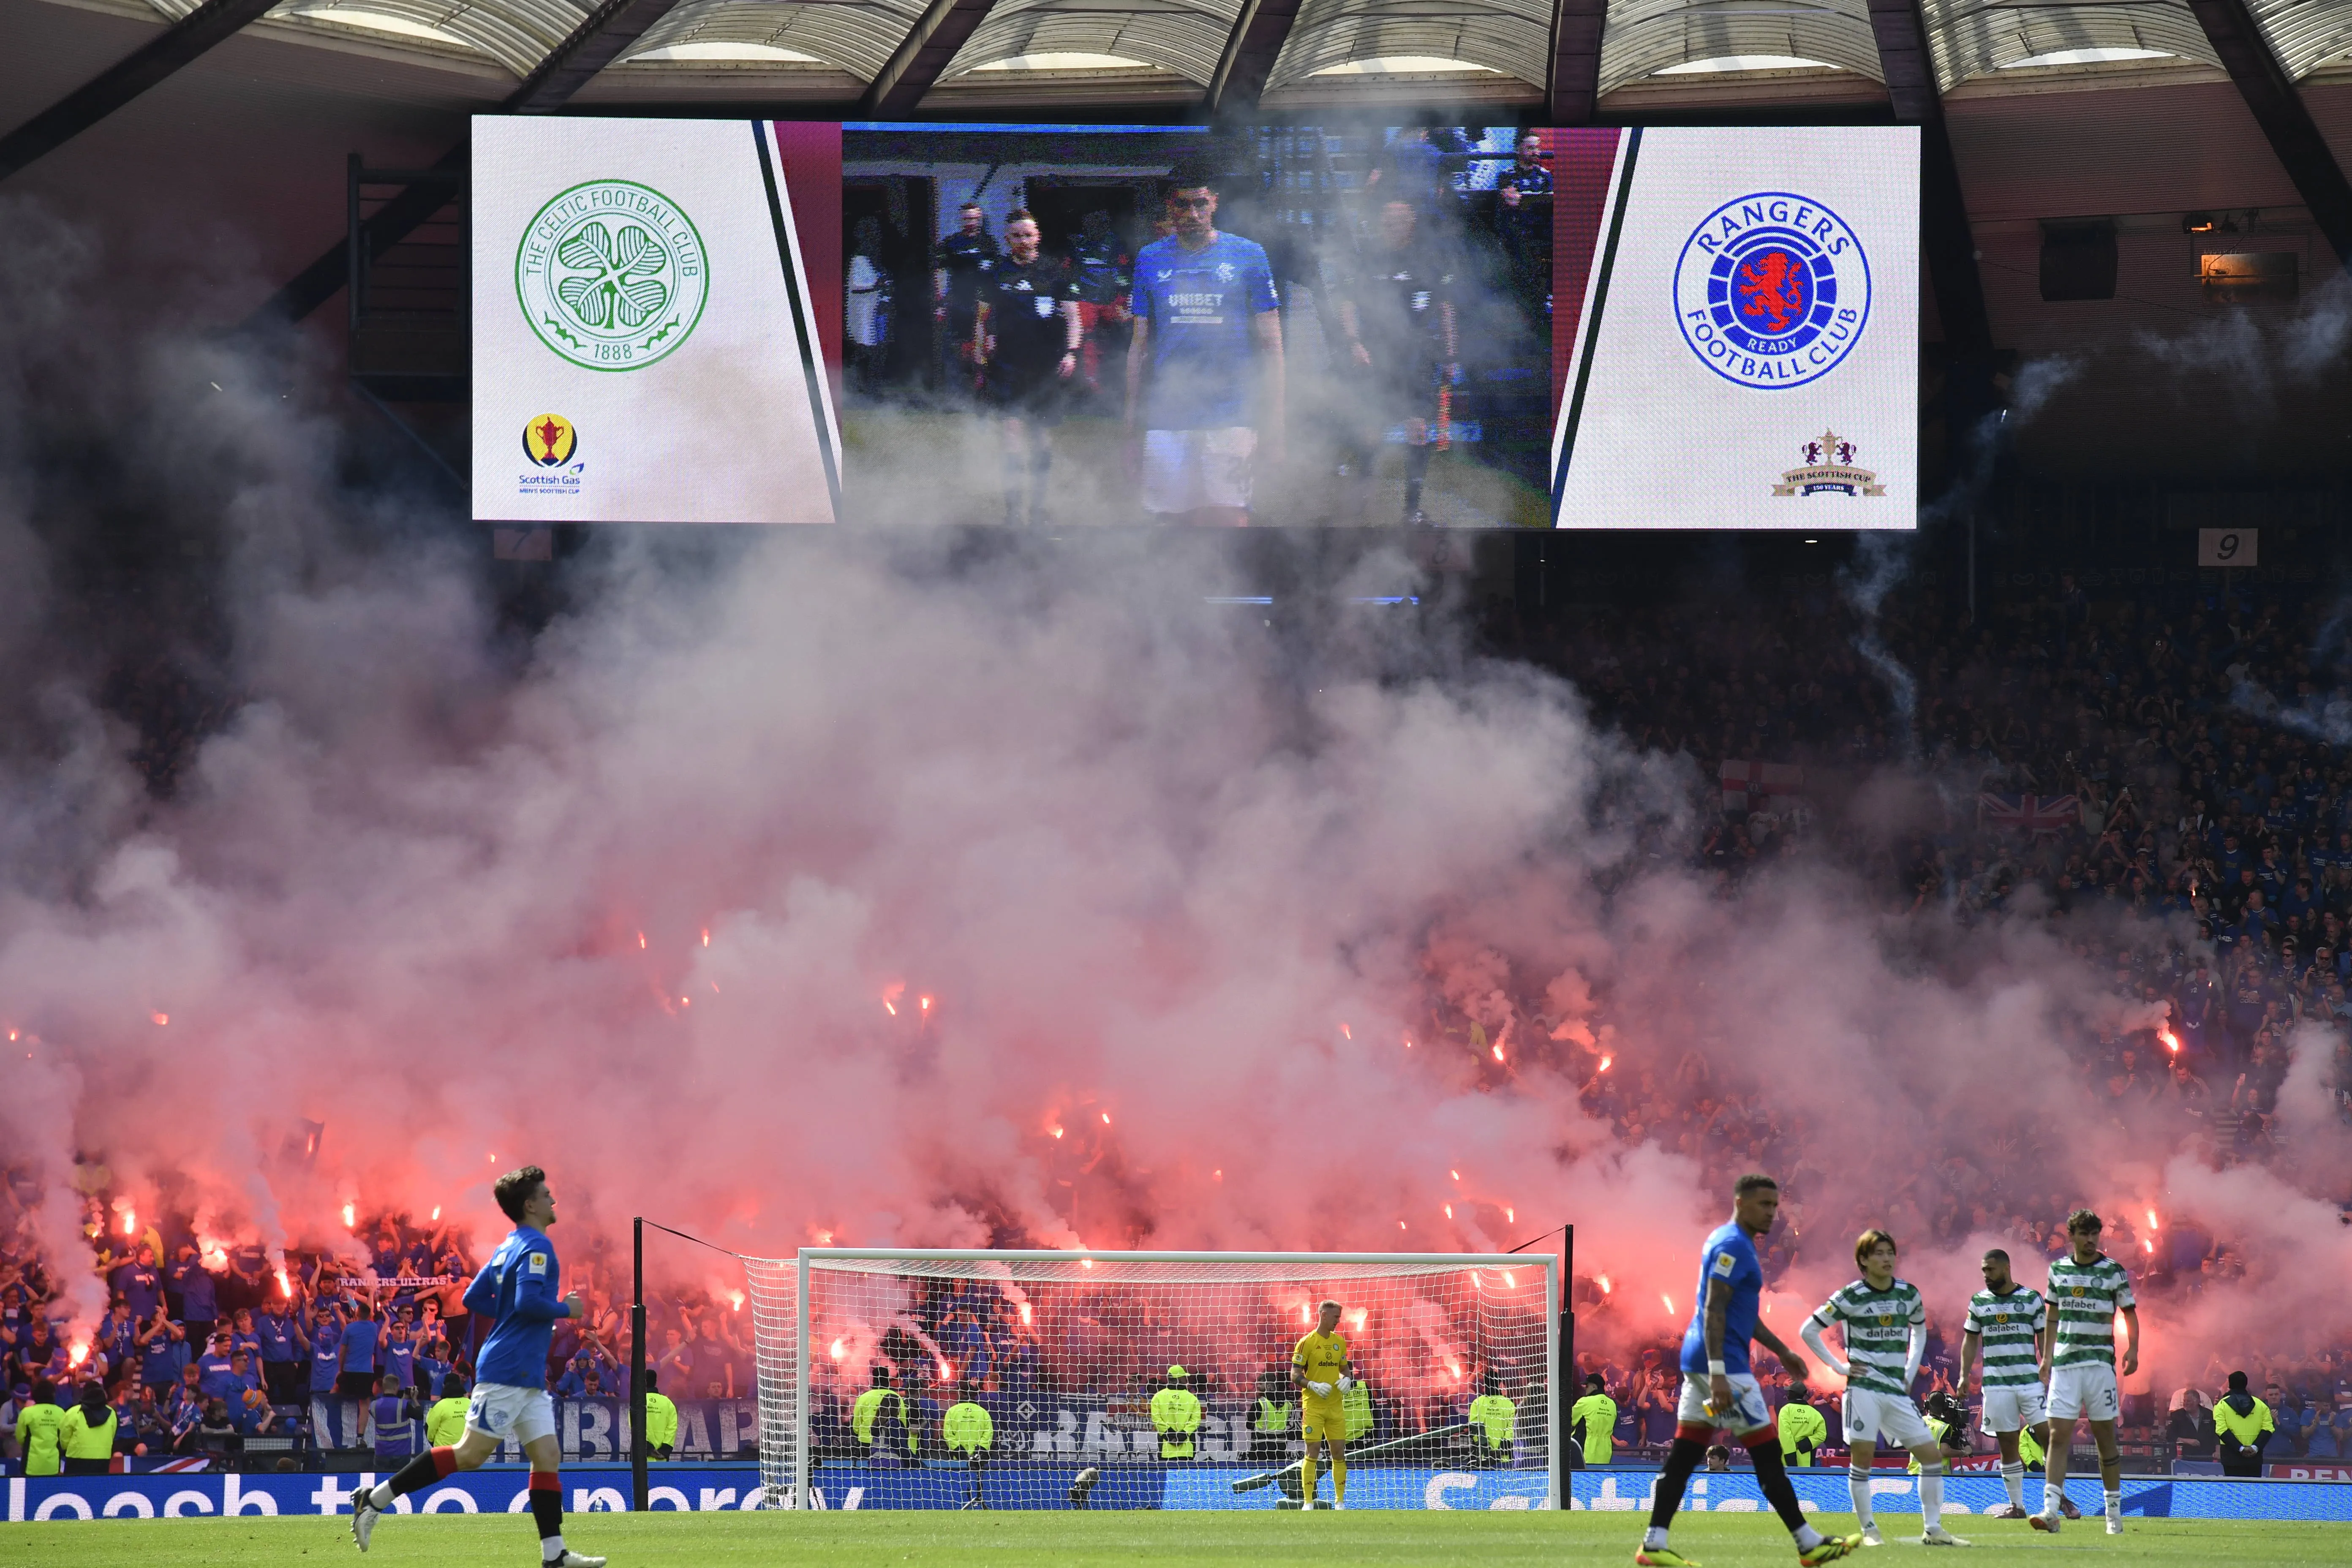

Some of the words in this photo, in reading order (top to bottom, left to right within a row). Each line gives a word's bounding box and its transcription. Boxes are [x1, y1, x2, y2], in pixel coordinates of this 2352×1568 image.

[536, 196, 588, 240] CELTIC
[592, 190, 673, 233] FOOTBALL
[1697, 201, 1849, 256] RANGERS
[526, 242, 547, 277] THE
[672, 231, 698, 277] CLUB
[1168, 293, 1224, 307] UNIBET
[593, 343, 632, 360] 1888
[1687, 309, 1807, 380] FOOTBALL
[1808, 308, 1858, 365] CLUB
[1748, 337, 1798, 354] READY
[519, 475, 559, 484] Scottish
[562, 475, 580, 485] Gas
[1786, 473, 1805, 482] THE
[1807, 471, 1851, 479] SCOTTISH
[1854, 474, 1871, 482] CUP
[2217, 534, 2239, 560] 9
[400, 1277, 447, 1286] ULTRAS
[2061, 1299, 2096, 1310] dafabet
[1866, 1327, 1903, 1338] dafabet
[1988, 1323, 2020, 1333] dafabet
